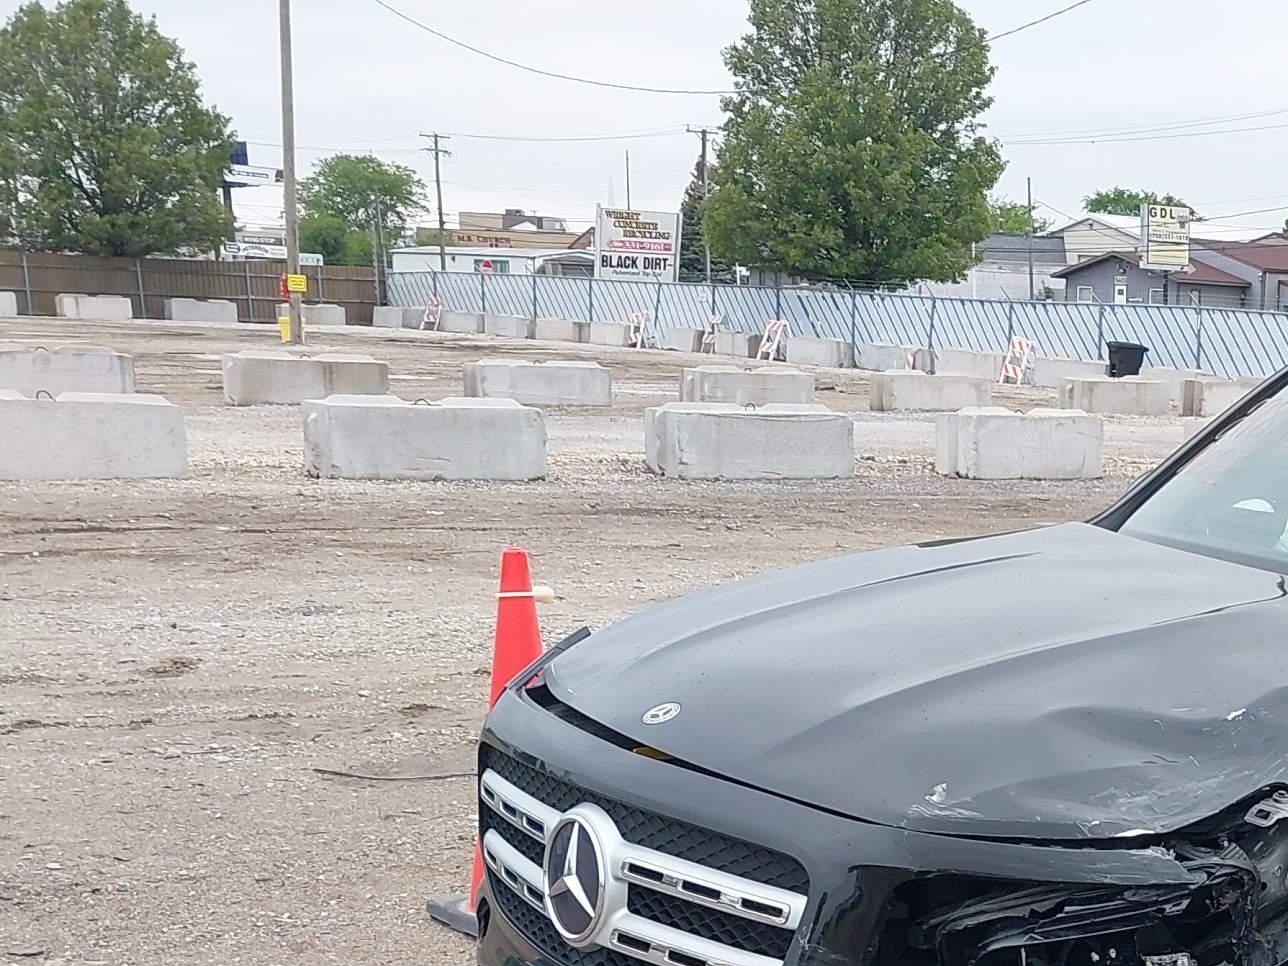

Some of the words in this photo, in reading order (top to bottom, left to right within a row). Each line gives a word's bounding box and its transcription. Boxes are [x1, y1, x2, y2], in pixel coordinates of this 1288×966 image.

[613, 220, 658, 230] CONCRETE
[623, 230, 670, 240] RECYCLING
[601, 254, 638, 269] BLACK
